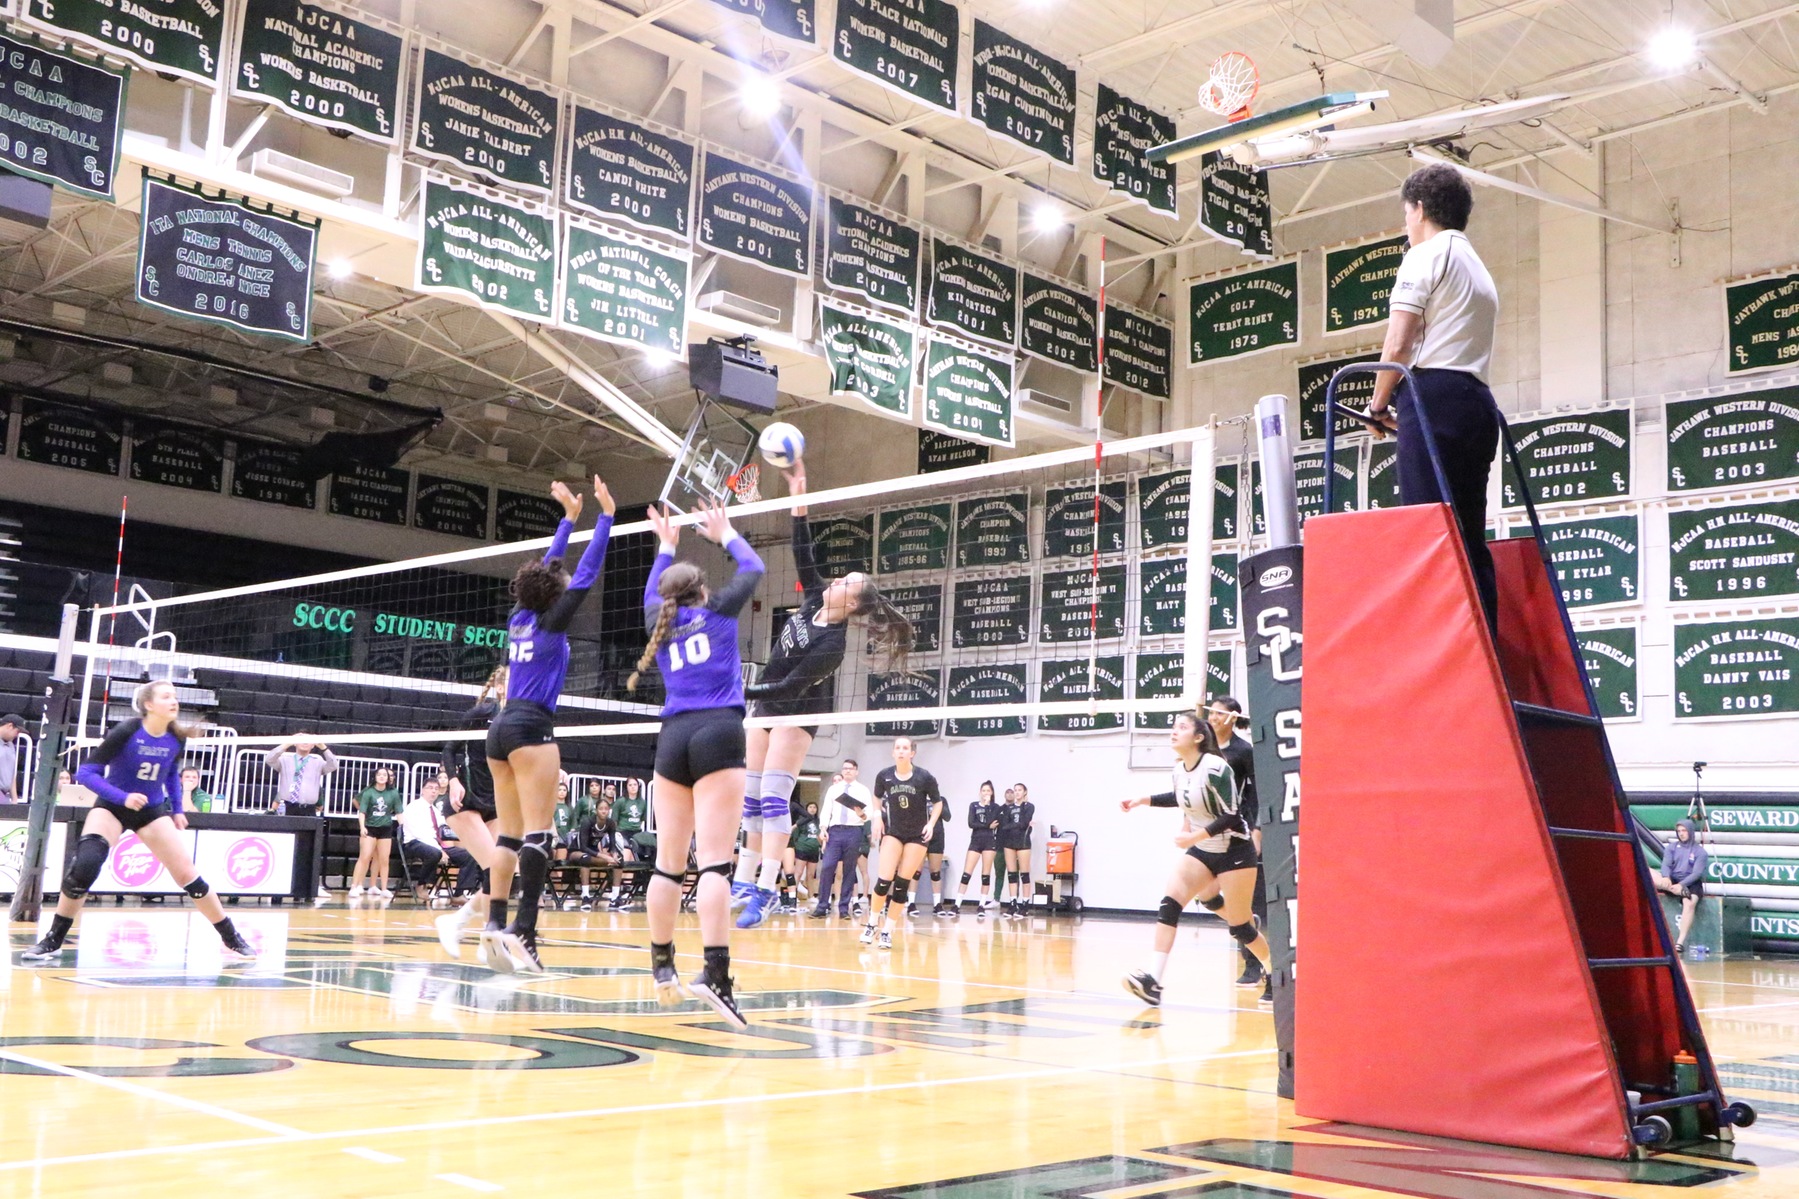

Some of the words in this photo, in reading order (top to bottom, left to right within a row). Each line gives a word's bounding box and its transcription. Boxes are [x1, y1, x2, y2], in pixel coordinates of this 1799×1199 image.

[119, 0, 203, 39] BASKETBALL
[296, 6, 355, 40] NJCAA
[101, 19, 155, 55] 2000
[850, 15, 886, 44] WOMENS
[890, 35, 944, 73] BASKETBALL
[292, 41, 356, 74] CHAMPIONS
[324, 41, 383, 70] ACADEMIC
[877, 56, 918, 87] 2007
[308, 71, 380, 106] BASKETBALL
[14, 81, 104, 123] CHAMPIONS
[290, 90, 344, 117] 2000
[427, 75, 465, 95] NJCAA
[471, 76, 553, 134] ALL-AMERICAN
[0, 103, 100, 152] BASKETBALL
[438, 93, 481, 117] WOMENS
[482, 108, 543, 138] BASKETBALL
[445, 118, 480, 139] JAMIE
[484, 131, 532, 156] TALBERT
[575, 129, 607, 150] NJCAA
[1006, 115, 1044, 143] 2007
[465, 146, 506, 173] 2000
[589, 144, 625, 165] WOMENS
[627, 156, 680, 184] BASKETBALL
[599, 168, 633, 188] CANDI
[635, 180, 667, 198] WHITE
[610, 192, 651, 217] 2000
[705, 172, 739, 194] JAYHAWK
[739, 172, 777, 194] WESTERN
[777, 188, 809, 225] DIVISION
[732, 192, 784, 218] CHAMPIONS
[427, 204, 468, 229] NJCAA
[713, 204, 747, 225] WOMENS
[749, 217, 801, 242] BASKETBALL
[149, 214, 175, 236] ITA
[175, 208, 241, 227] NATIONAL
[242, 218, 308, 273] CHAMPIONS
[182, 228, 221, 251] MENS
[227, 238, 273, 264] TENNIS
[736, 235, 772, 259] 2001
[176, 247, 234, 272] CARLOS
[597, 262, 611, 275] OF
[612, 265, 632, 281] THE
[1329, 256, 1366, 289] JAYHAWK
[1366, 244, 1405, 262] WESTERN
[176, 264, 236, 288] ONDREJ
[238, 279, 271, 298] NICE
[599, 245, 650, 270] NATIONAL
[654, 265, 683, 301] COACH
[1360, 266, 1399, 283] CHAMPIO
[471, 273, 508, 300] 2002
[577, 273, 615, 295] WOMENS
[618, 285, 675, 312] BASKETBALL
[1195, 291, 1222, 319] NJCAA
[1224, 279, 1293, 300] ALL-AMERICAN
[1371, 290, 1391, 301] GOL
[194, 293, 250, 320] 2016
[590, 298, 610, 314] JIM
[1230, 299, 1256, 313] GOLF
[1353, 306, 1379, 322] 1974
[1734, 290, 1778, 325] JAYHAWK
[604, 318, 646, 341] 2001
[957, 309, 985, 331] 2001
[1213, 318, 1243, 333] TERRY
[1244, 312, 1274, 327] RINEY
[1230, 334, 1259, 350] 1973
[1751, 331, 1780, 344] MENS
[1046, 342, 1076, 361] 2002
[1302, 373, 1330, 401] NJCAA
[48, 423, 97, 439] CHAMPIONS
[1669, 408, 1711, 443] JAYHAWK
[1713, 400, 1766, 416] WESTERN
[1704, 418, 1775, 438] CHAMPIONS
[44, 436, 98, 453] BASEBALL
[1542, 422, 1586, 436] WESTERN
[1588, 424, 1627, 449] DIVISION
[1702, 438, 1778, 458] BASEBALL
[152, 455, 203, 470] BASEBALL
[1533, 442, 1595, 459] CHAMPIONS
[160, 472, 193, 485] 2004
[1530, 461, 1597, 478] BASEBALL
[1715, 462, 1766, 480] 2003
[1541, 482, 1587, 498] 2002
[1551, 528, 1636, 555] ALL-AMERICAN
[1671, 524, 1705, 554] NJCAA
[1706, 515, 1727, 531] HM
[1704, 533, 1776, 550] BASEBALL
[1550, 547, 1604, 563] ASEBALL
[1689, 558, 1727, 571] SCOTT
[1732, 552, 1796, 568] SANDUSKY
[1573, 565, 1612, 580] EYLAR
[1716, 576, 1767, 592] 1996
[292, 602, 356, 633] SCCC
[374, 613, 457, 642] STUDENT
[668, 632, 711, 672] 10
[1675, 639, 1710, 668] NJCAA
[1711, 631, 1732, 646] HM
[1710, 649, 1783, 665] BASEBALL
[1703, 671, 1750, 684] DANNY
[1758, 669, 1791, 682] VAIS
[1722, 694, 1773, 710] 2003
[977, 720, 1004, 729] 1998
[1068, 715, 1096, 728] 2000
[136, 761, 161, 781] 21
[1710, 809, 1799, 827] SEWARD
[1708, 862, 1799, 881] COUNTY
